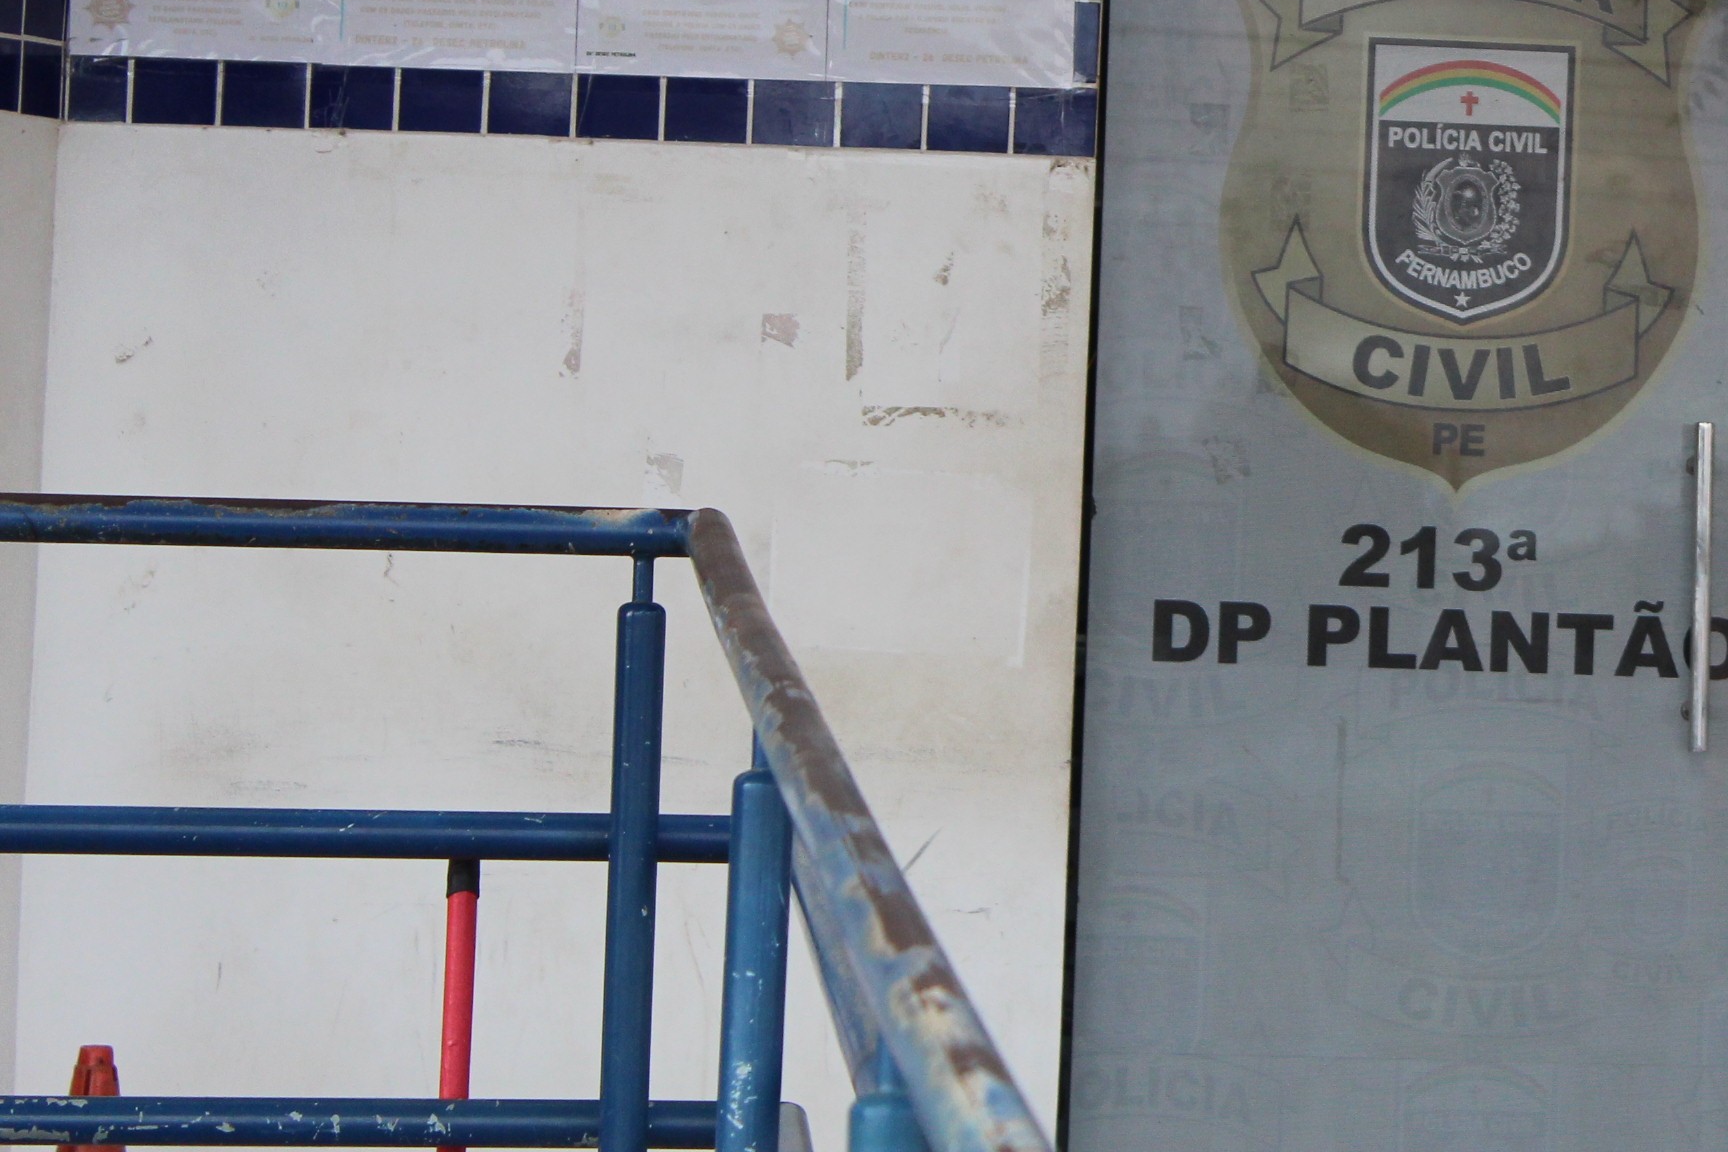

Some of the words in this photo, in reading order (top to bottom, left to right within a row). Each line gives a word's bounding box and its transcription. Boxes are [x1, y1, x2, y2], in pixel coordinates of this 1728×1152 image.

[1387, 124, 1482, 152] POLÍCIA
[1488, 131, 1548, 154] CIVIL
[1395, 247, 1531, 289] PERNAMBUCO
[1352, 334, 1570, 401] CIVIL
[1431, 422, 1485, 456] PE
[1339, 524, 1536, 591] 213ª
[1152, 598, 1272, 665] DP
